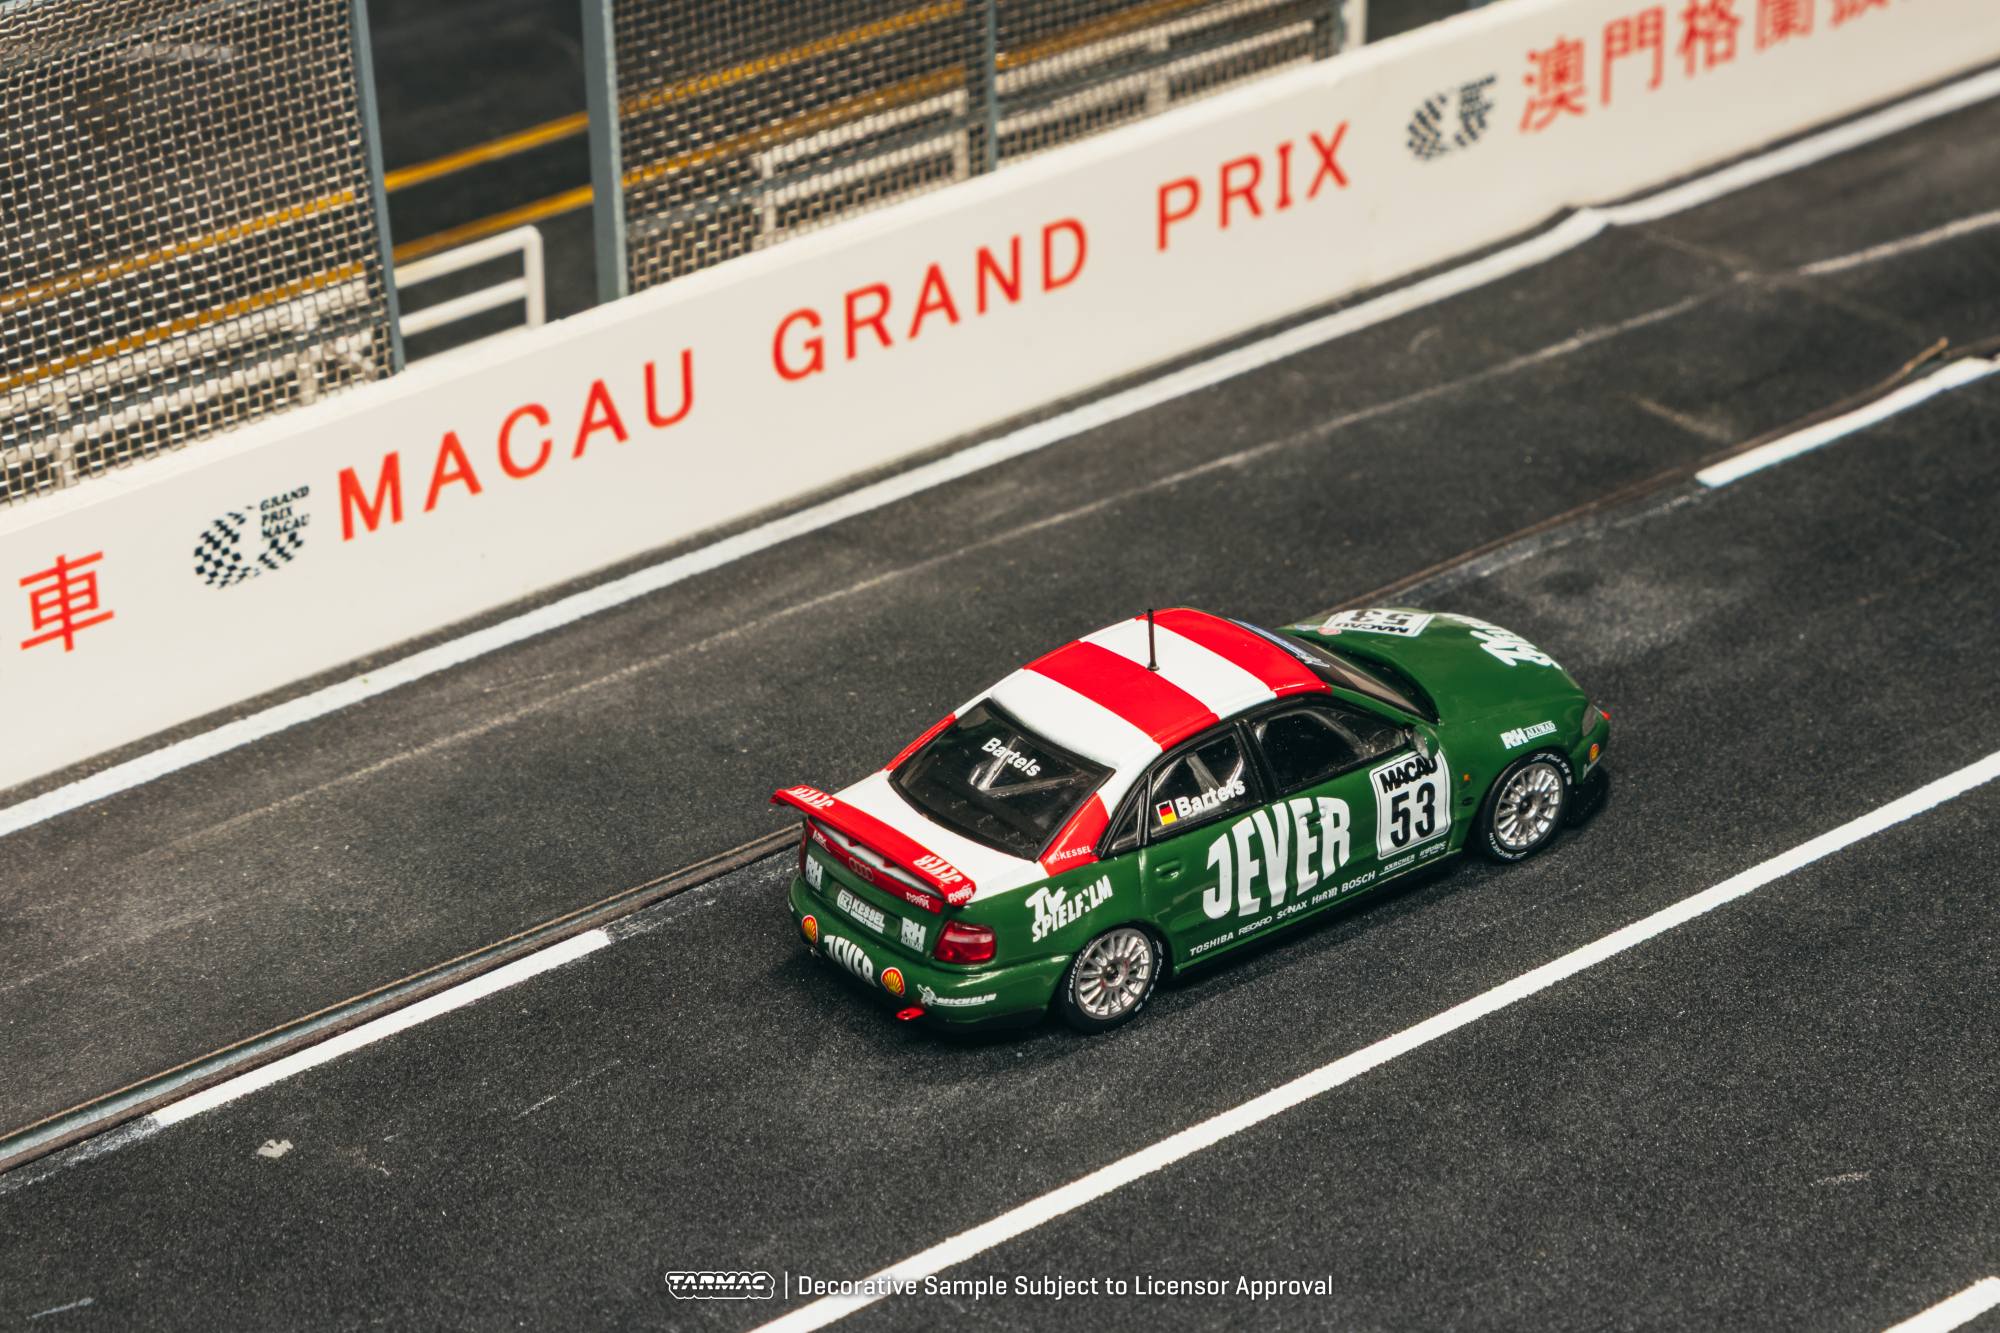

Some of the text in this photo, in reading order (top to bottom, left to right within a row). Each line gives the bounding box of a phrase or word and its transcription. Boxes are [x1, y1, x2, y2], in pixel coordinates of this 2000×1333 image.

[337, 122, 1348, 542] MACAU GRAND PRIX
[260, 485, 309, 511] GRAND
[261, 506, 292, 527] PRIX
[262, 513, 310, 538] MACAU
[18, 551, 115, 653] 車
[1335, 622, 1410, 634] MACAU
[981, 737, 1041, 777] Bartels
[1379, 756, 1438, 794] MACAU
[1175, 780, 1246, 818] Bartels
[1390, 782, 1436, 848] 53
[912, 854, 964, 885] JEVER
[1060, 845, 1092, 860] KESSEL
[1201, 796, 1351, 920] JEVER
[851, 898, 885, 928] KESSEL
[1024, 886, 1068, 921] TV
[1189, 931, 1235, 957] TOSHIBA
[1237, 915, 1273, 936] RECARO
[1276, 900, 1309, 920] SONAX
[1341, 870, 1376, 893] BOSCH
